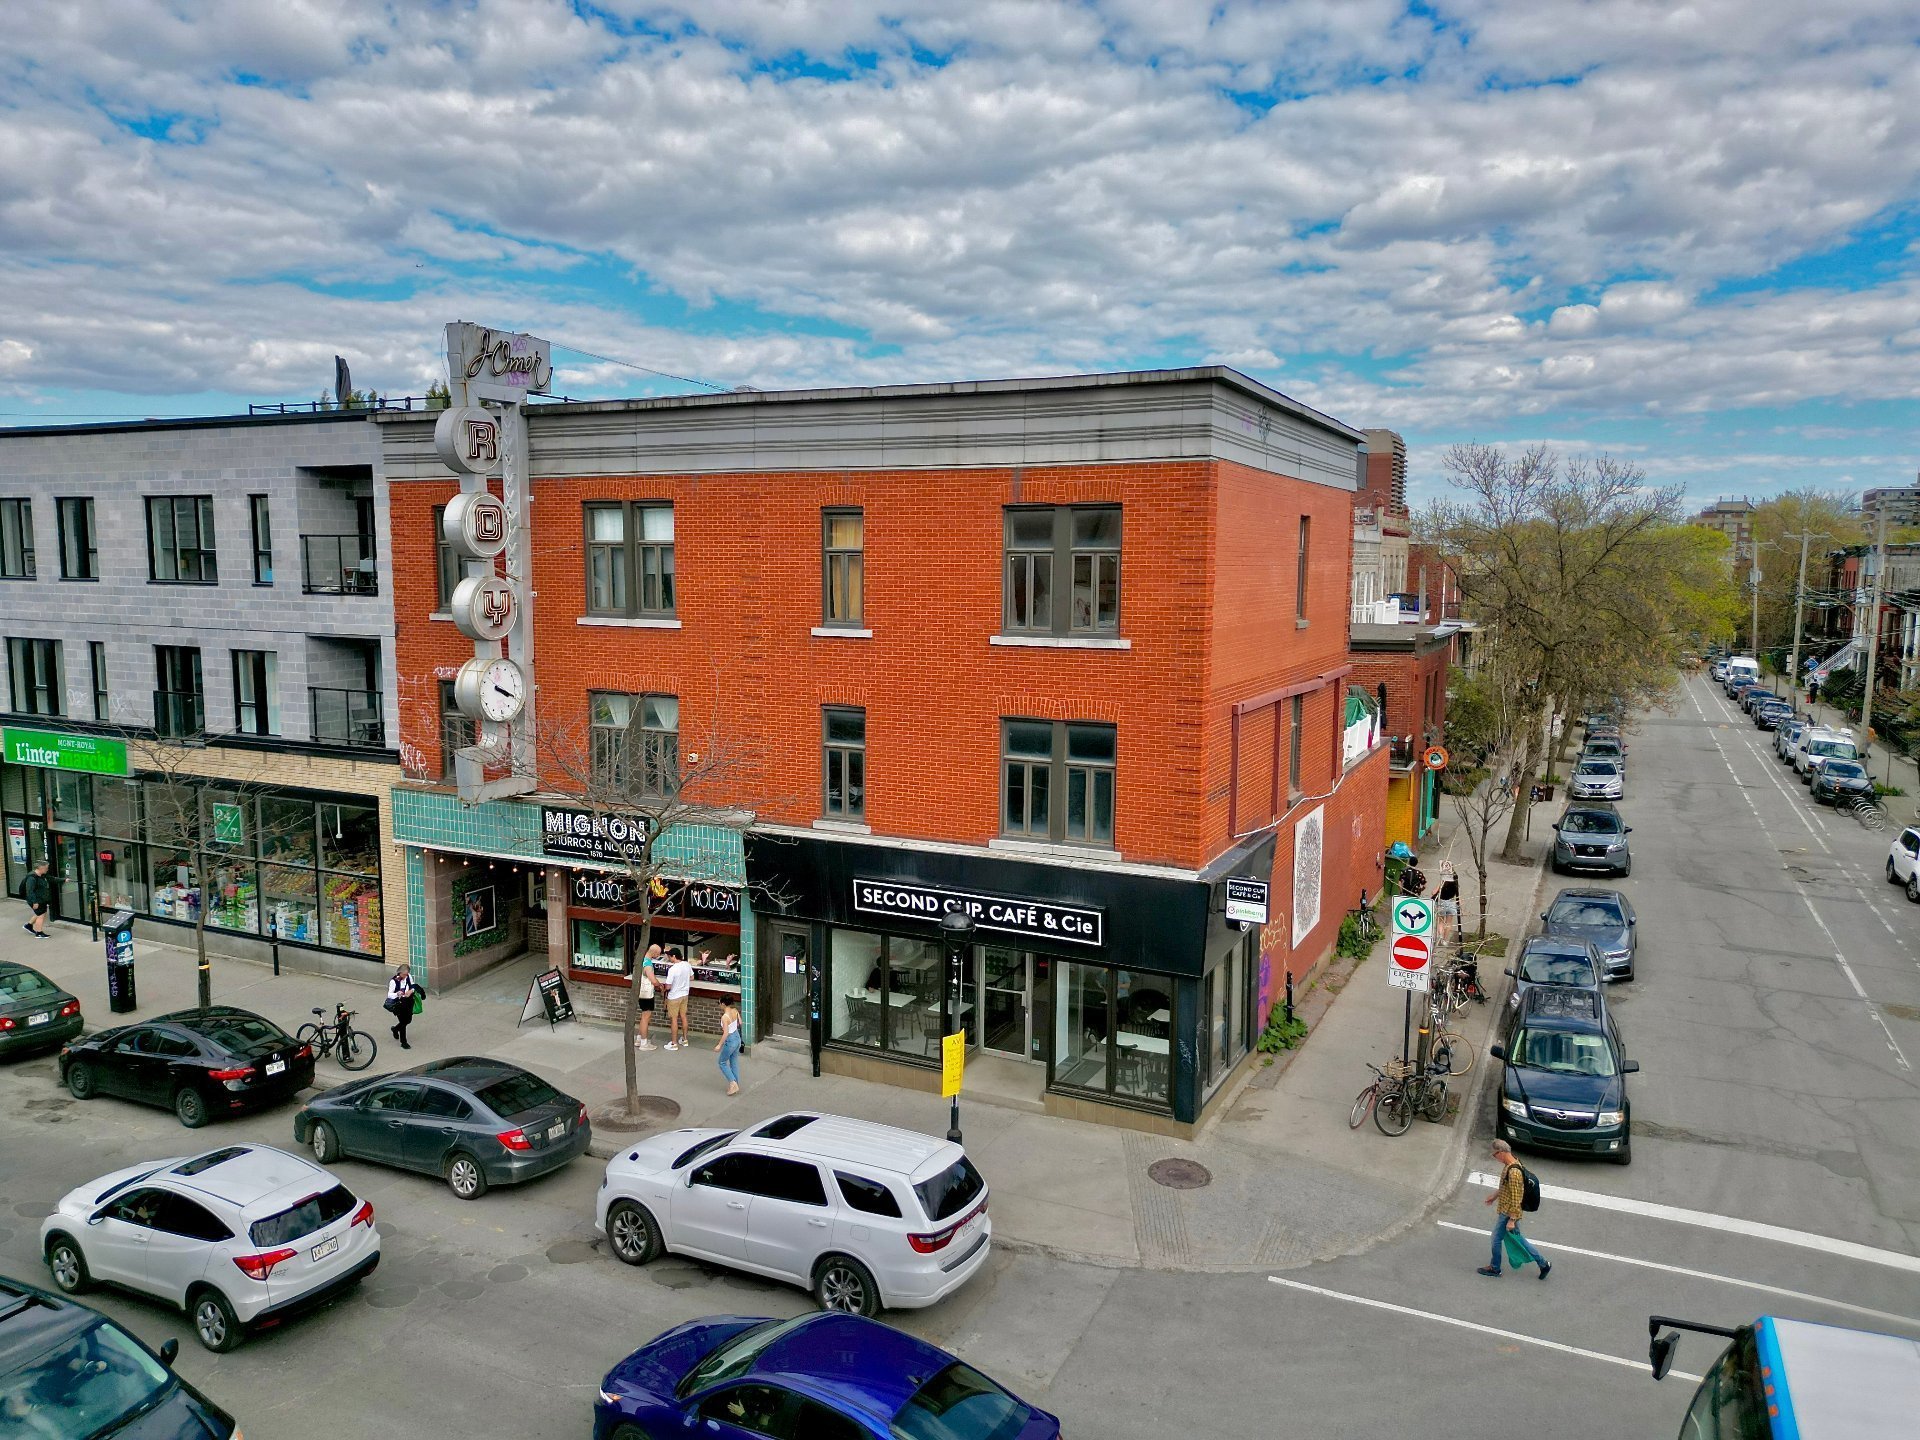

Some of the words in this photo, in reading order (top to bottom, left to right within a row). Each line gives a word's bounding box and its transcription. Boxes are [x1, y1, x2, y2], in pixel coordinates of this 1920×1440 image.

[57, 738, 96, 750] MONT-ROYAL
[545, 811, 646, 842] MIGNON
[546, 834, 592, 849] CHURROS
[594, 840, 603, 850] &
[667, 900, 676, 913] &
[690, 888, 740, 912] NOUGAT
[862, 887, 939, 912] SECOND
[989, 906, 1038, 927] CAFÉ
[1043, 912, 1059, 930] &
[1061, 915, 1094, 935] Cie
[574, 952, 623, 971] CHURROS
